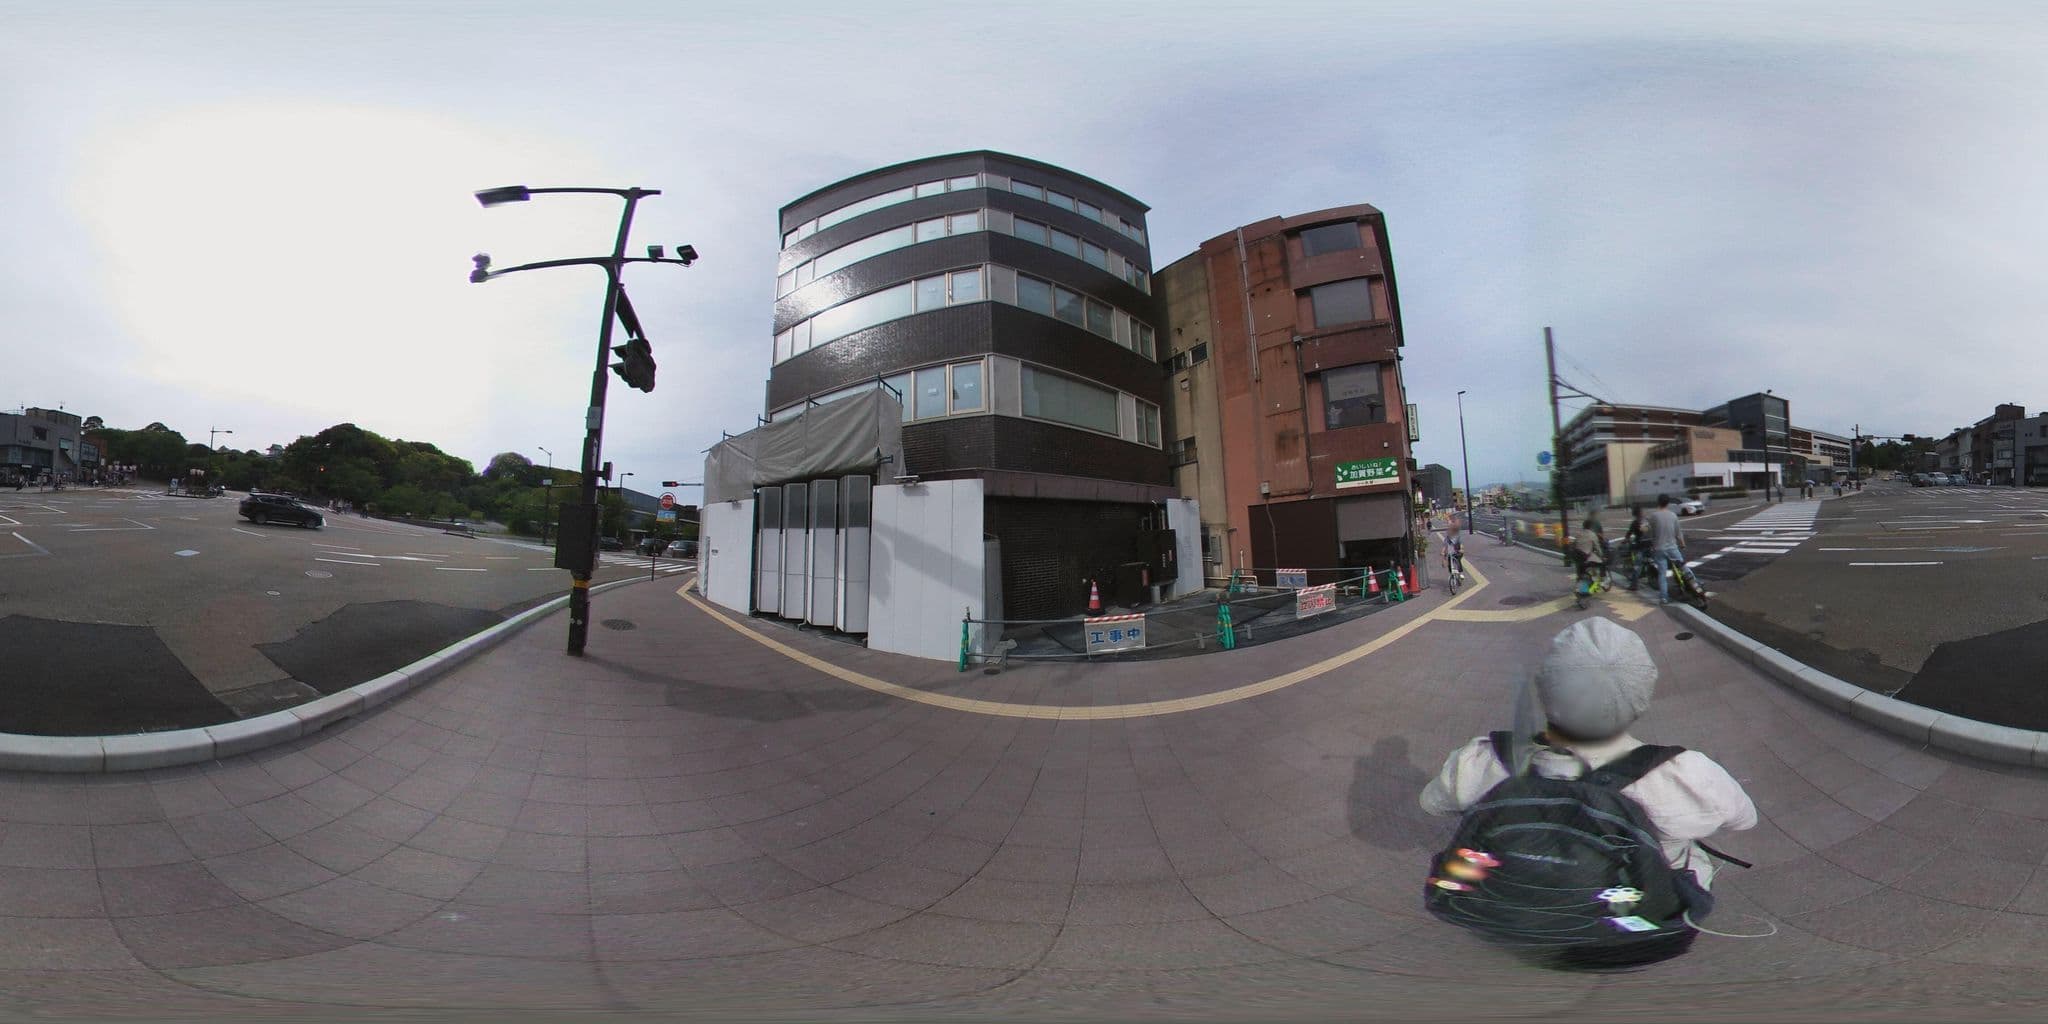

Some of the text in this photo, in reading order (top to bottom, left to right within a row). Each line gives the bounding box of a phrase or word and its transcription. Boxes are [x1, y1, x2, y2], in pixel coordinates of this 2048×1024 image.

[1349, 467, 1384, 479] 加賀野菜
[1090, 627, 1140, 644] 工事中
